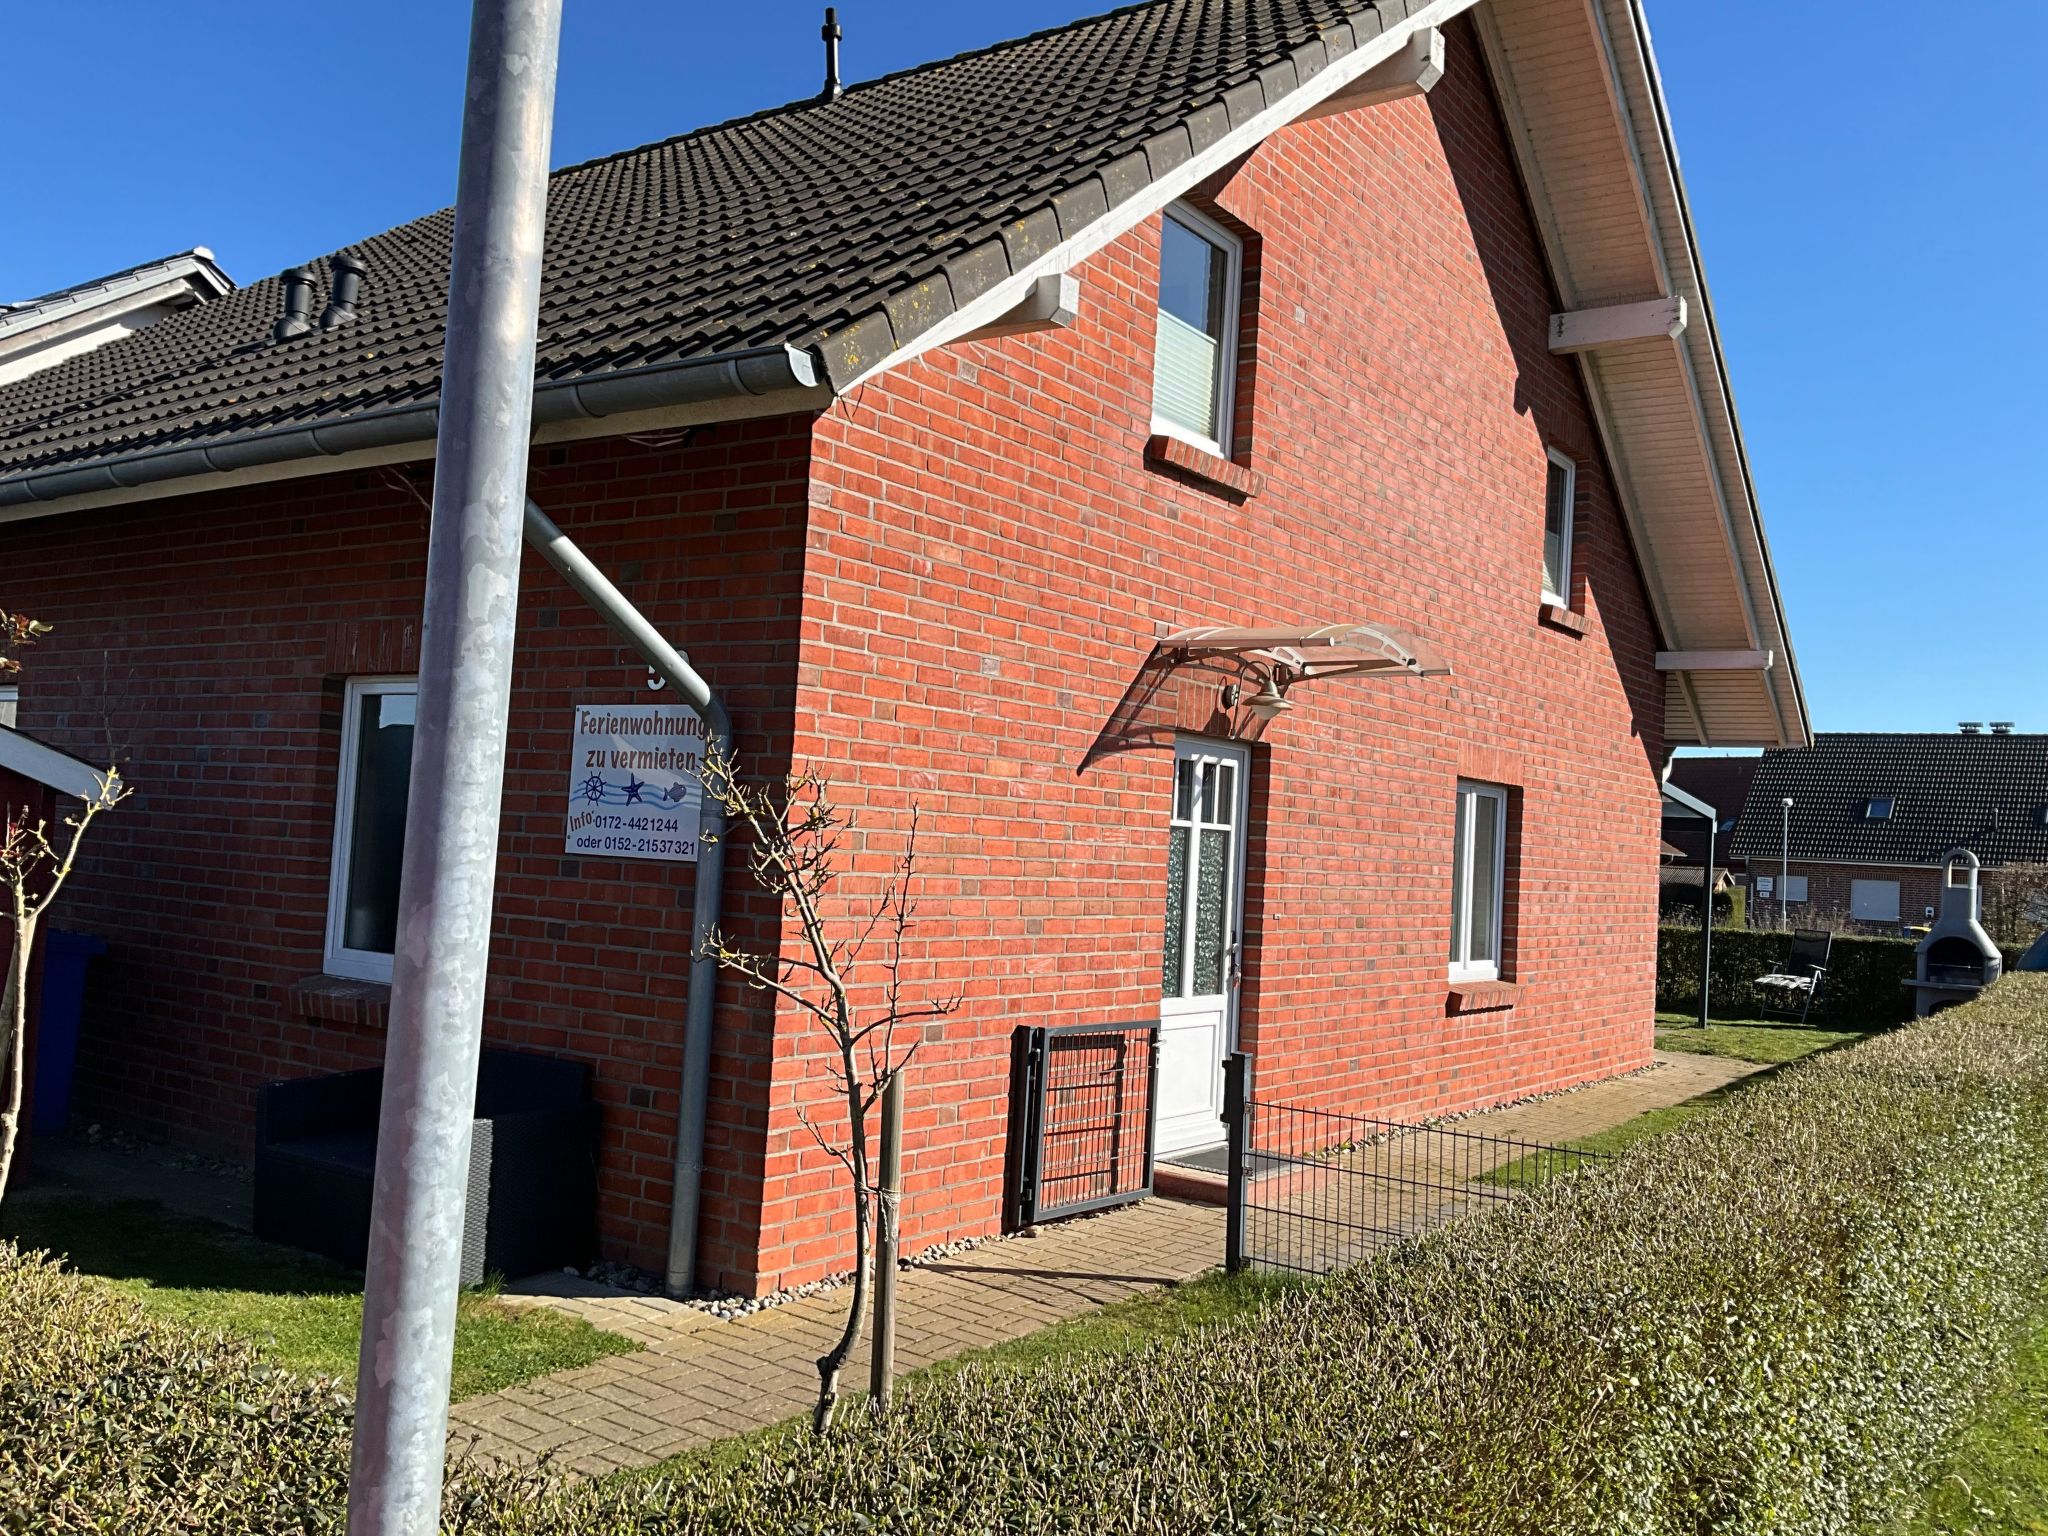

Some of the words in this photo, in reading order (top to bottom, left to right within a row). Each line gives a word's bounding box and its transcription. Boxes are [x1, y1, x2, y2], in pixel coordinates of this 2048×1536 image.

[580, 710, 706, 741] Ferienwohnung
[585, 750, 605, 768] zu
[611, 747, 696, 771] vermieten
[595, 815, 679, 833] 0172-4421244
[576, 835, 602, 849] oder
[604, 837, 695, 855] 0152-21537321
